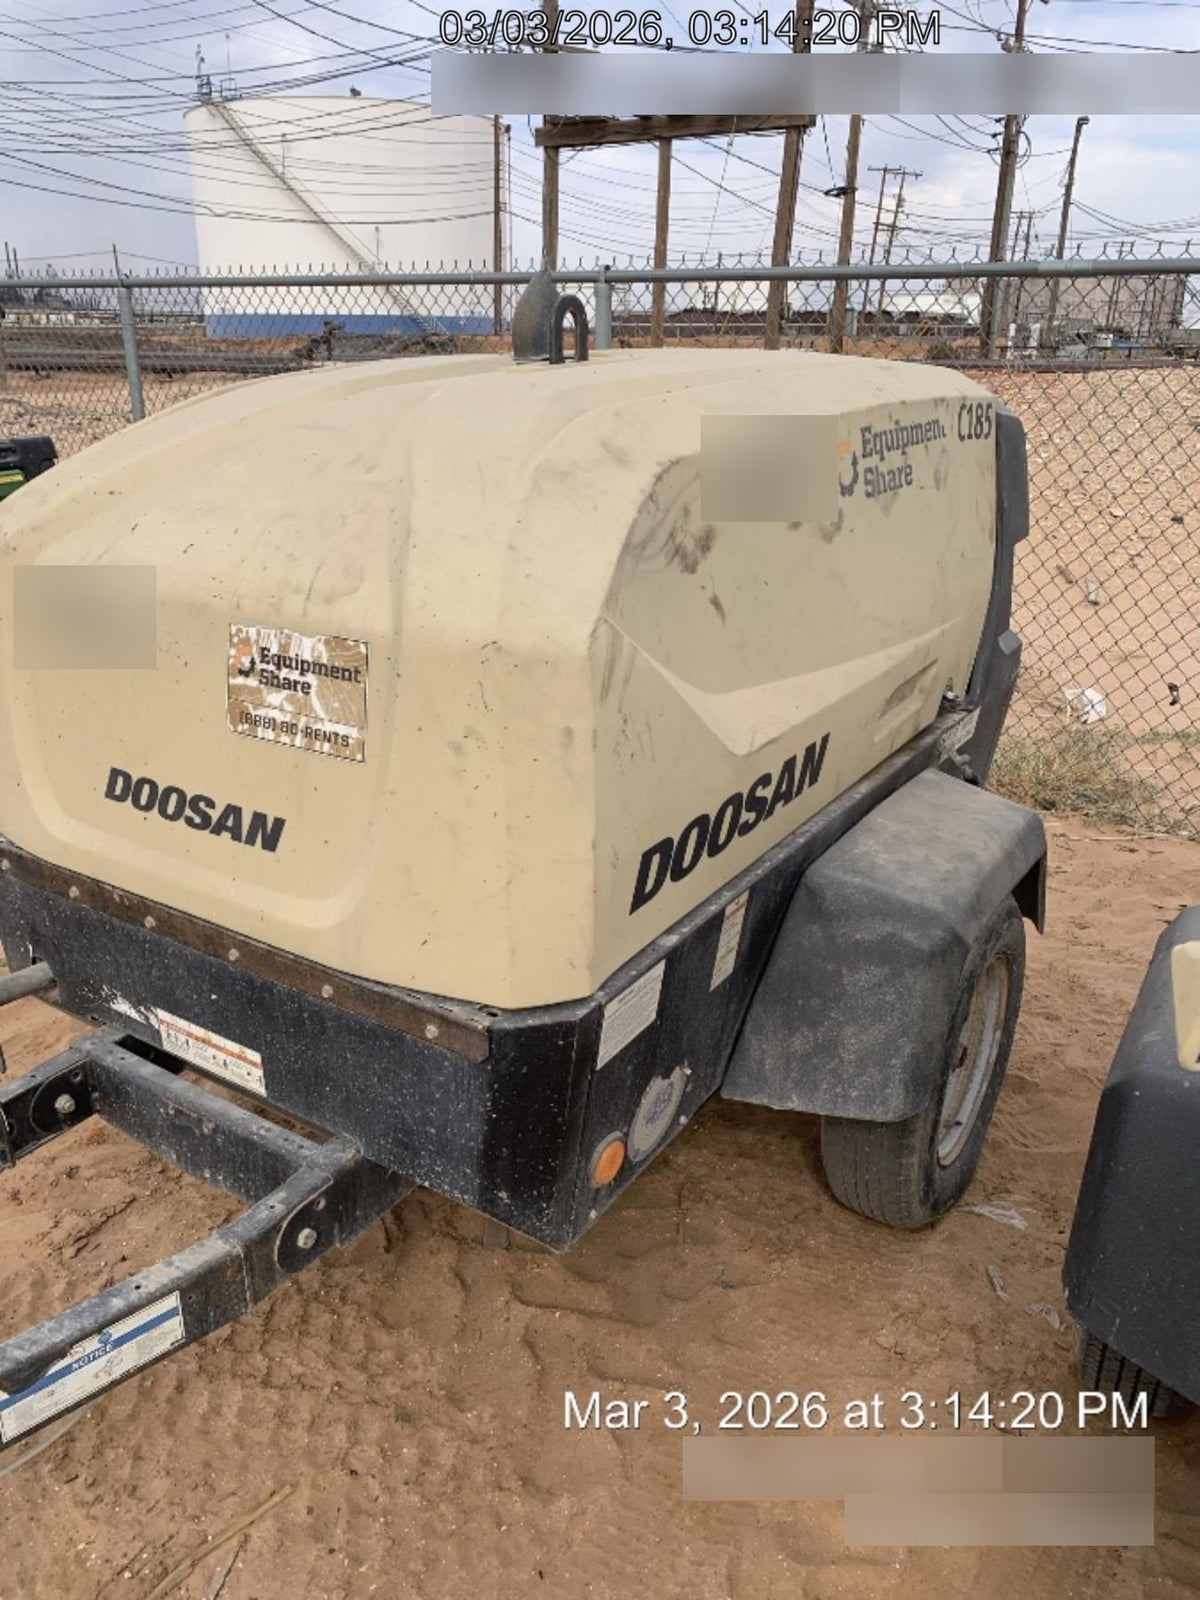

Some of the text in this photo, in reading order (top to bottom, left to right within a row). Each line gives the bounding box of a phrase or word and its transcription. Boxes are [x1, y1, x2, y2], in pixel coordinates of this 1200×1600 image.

[957, 402, 993, 442] C185
[863, 462, 914, 498] Share
[258, 646, 362, 684] Equipment
[258, 667, 312, 695] Share
[105, 766, 286, 853] DOOSAN
[629, 731, 831, 916] DOOSAN
